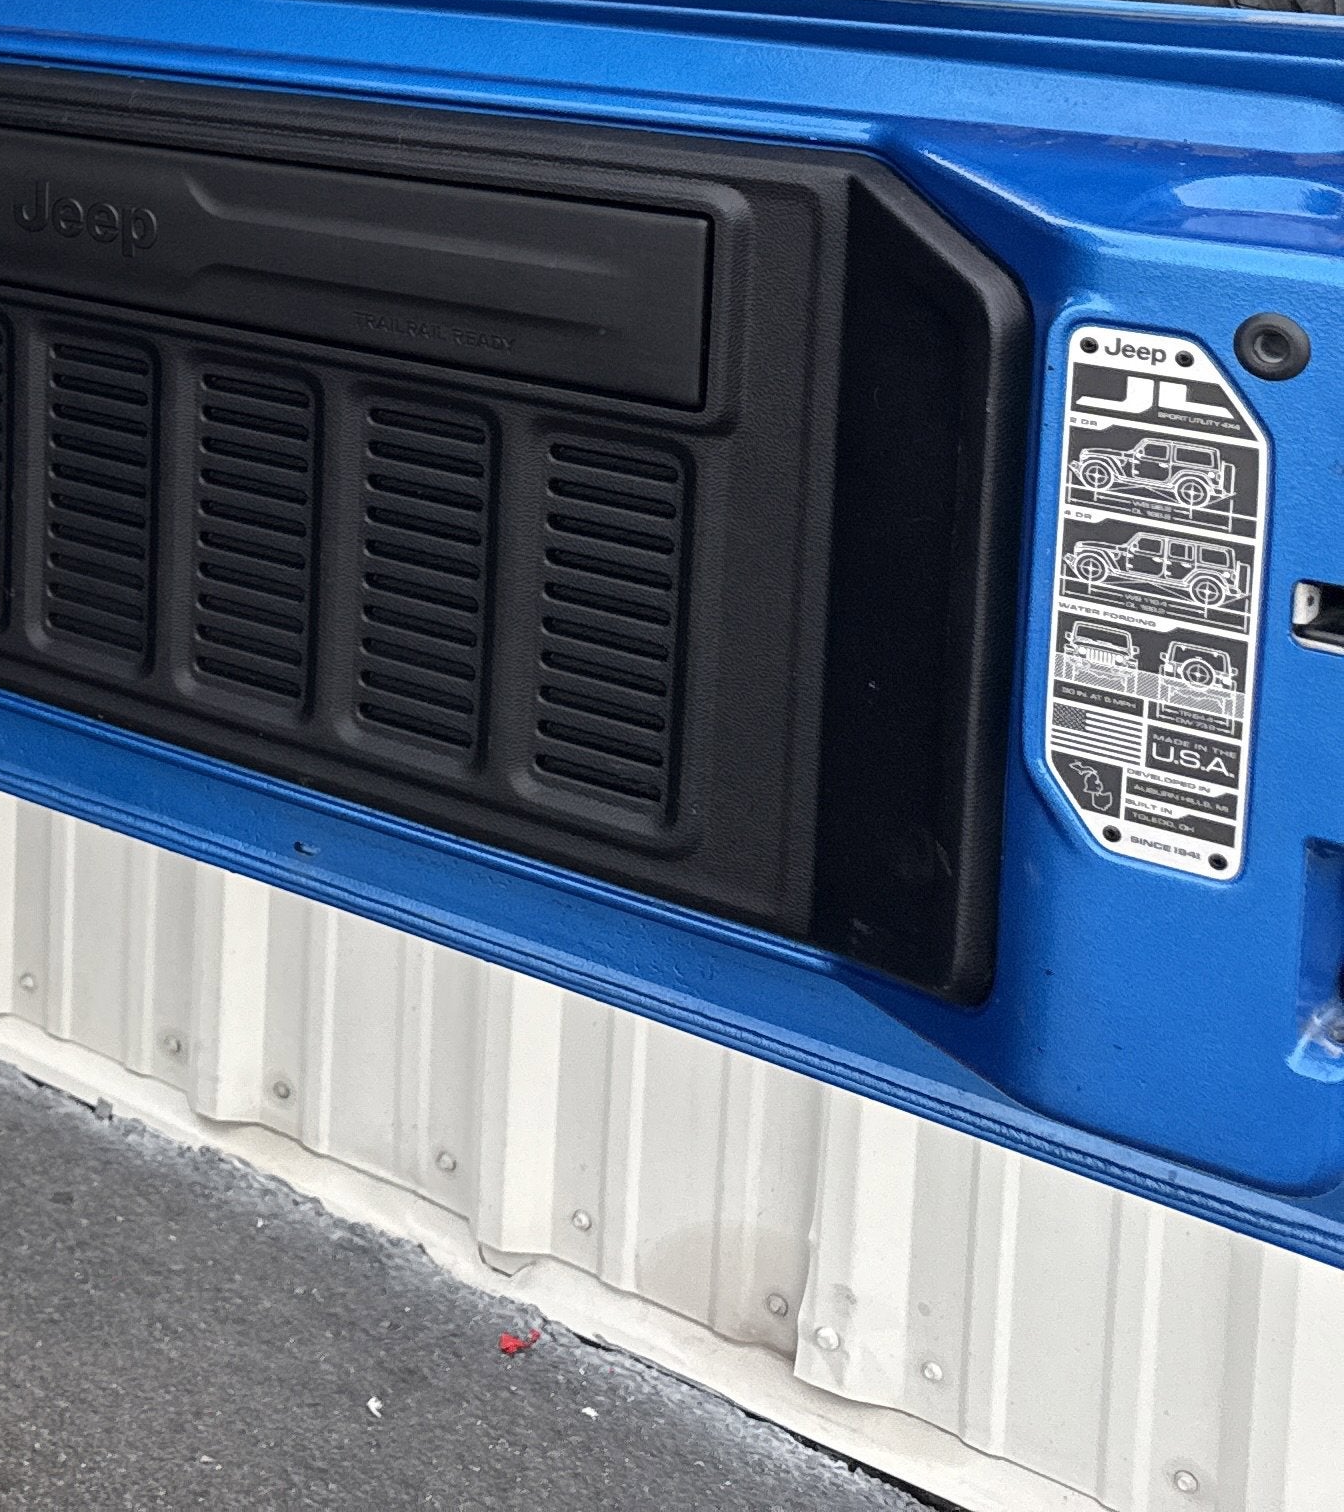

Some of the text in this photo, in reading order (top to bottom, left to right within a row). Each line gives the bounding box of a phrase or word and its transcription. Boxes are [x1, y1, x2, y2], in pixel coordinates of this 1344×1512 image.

[14, 180, 159, 258] Jeep
[1104, 337, 1167, 366] Jeep
[1075, 375, 1235, 420] JL
[1080, 418, 1098, 427] DR
[1157, 411, 1189, 424] SPORT
[1189, 417, 1220, 428] UTILITY
[1075, 511, 1092, 520] DR
[1058, 601, 1156, 627] WATER FORDING
[1112, 698, 1137, 709] MPH
[1153, 733, 1237, 760] MADE IN THE
[1152, 742, 1235, 779] U.S.A.
[1127, 768, 1211, 794] DEVELOPED IN
[1133, 784, 1179, 801] AUBURN
[1125, 797, 1173, 816] BUILT IN
[1178, 823, 1195, 833] OH
[1130, 835, 1201, 860] SINCE 1941
